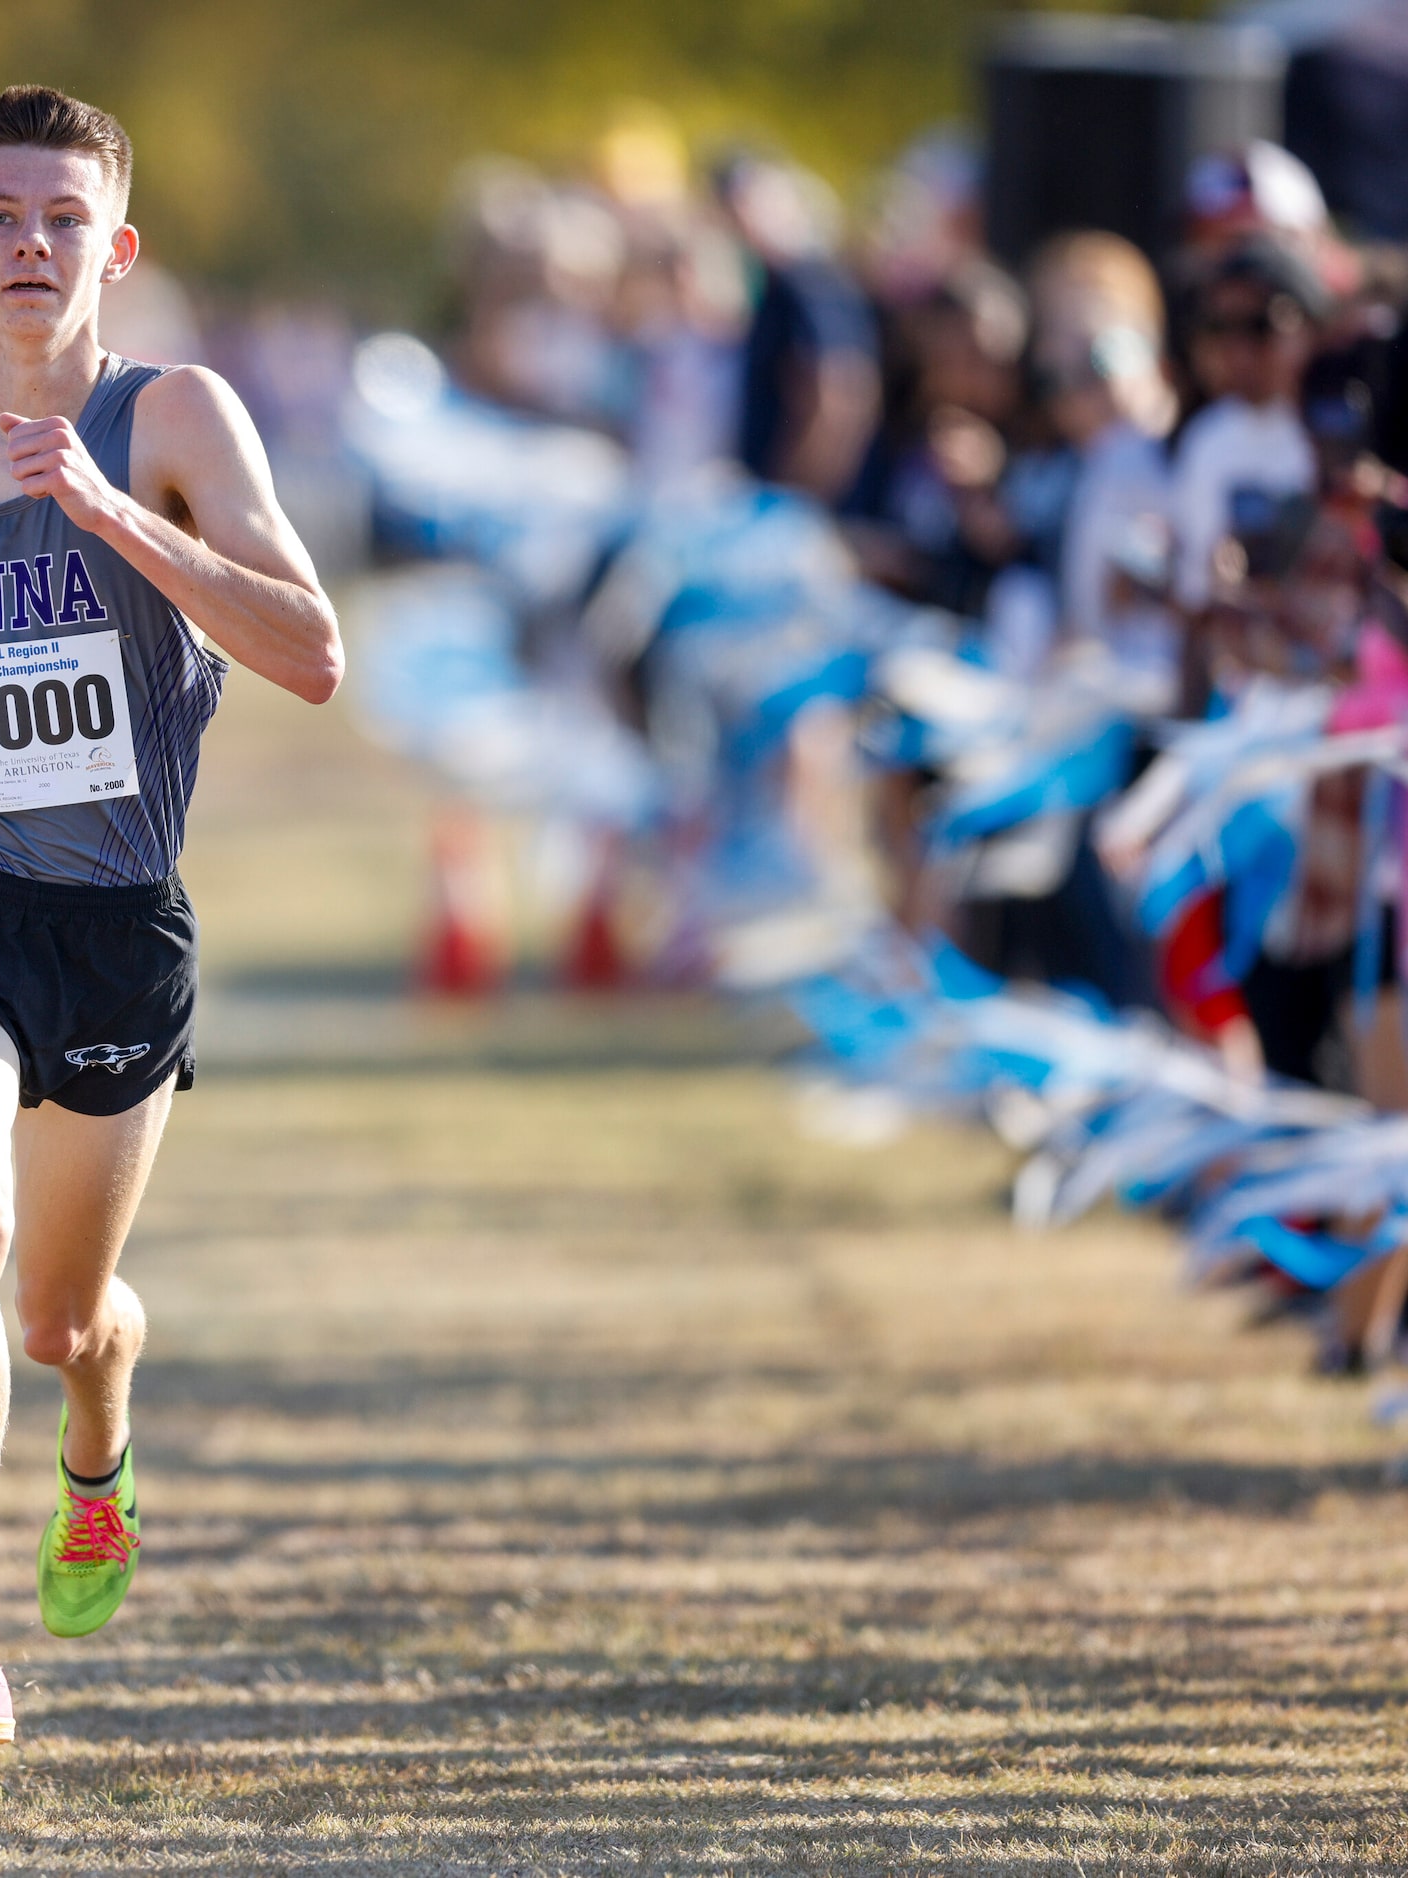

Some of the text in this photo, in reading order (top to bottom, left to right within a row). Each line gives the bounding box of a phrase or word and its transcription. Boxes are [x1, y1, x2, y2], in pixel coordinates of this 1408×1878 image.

[8, 644, 48, 660] Region
[51, 641, 60, 654] II
[10, 753, 47, 766] University
[48, 752, 58, 761] of
[58, 751, 80, 760] Texas
[4, 760, 74, 777] ARLINGTON
[89, 779, 125, 793] No. 2000
